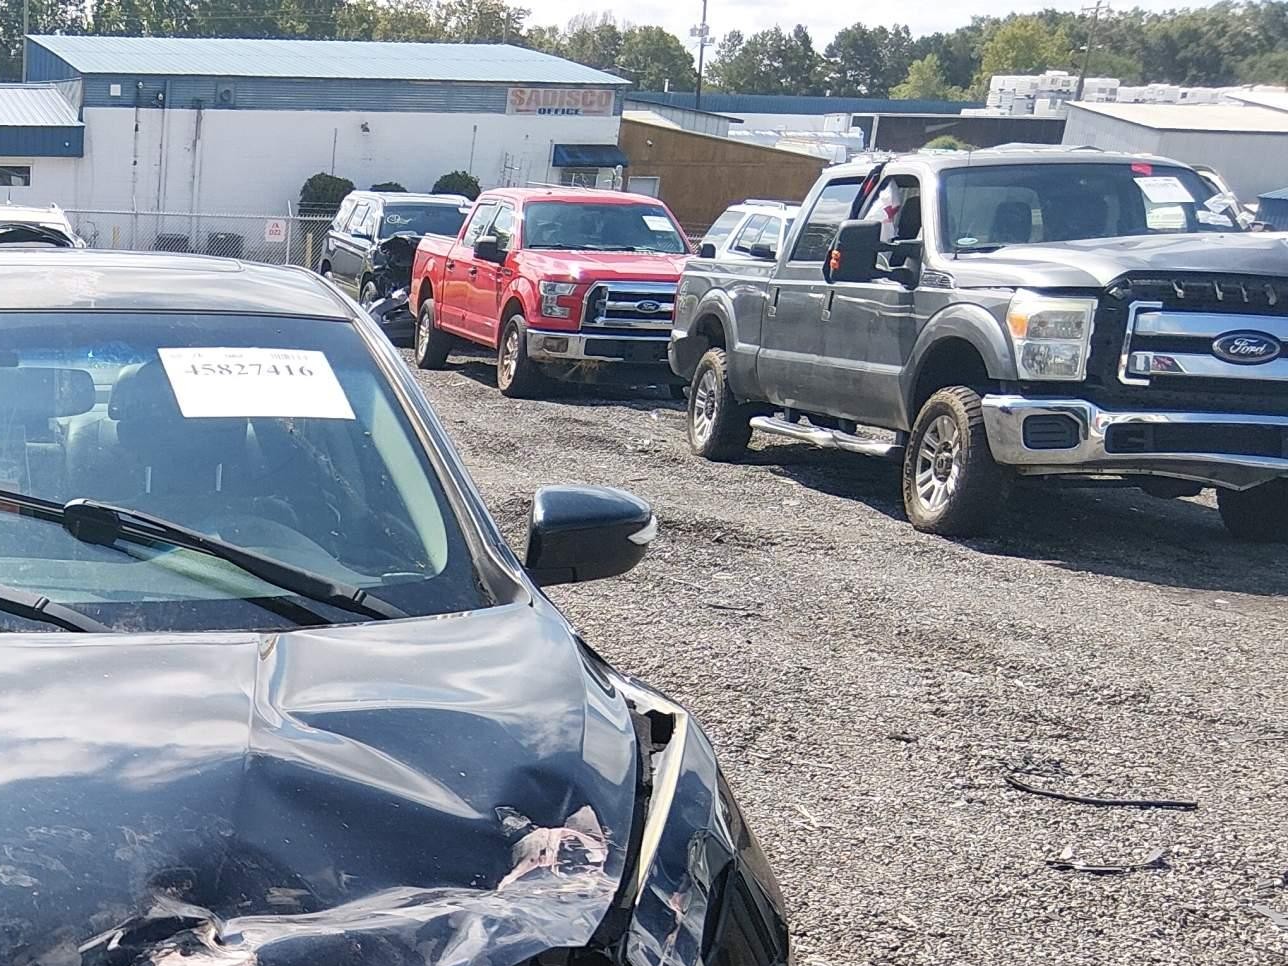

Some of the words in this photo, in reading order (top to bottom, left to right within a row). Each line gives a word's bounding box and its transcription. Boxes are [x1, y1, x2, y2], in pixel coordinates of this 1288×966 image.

[512, 91, 611, 107] SADISCO
[1228, 337, 1268, 355] Ford
[184, 363, 314, 377] 45827416
